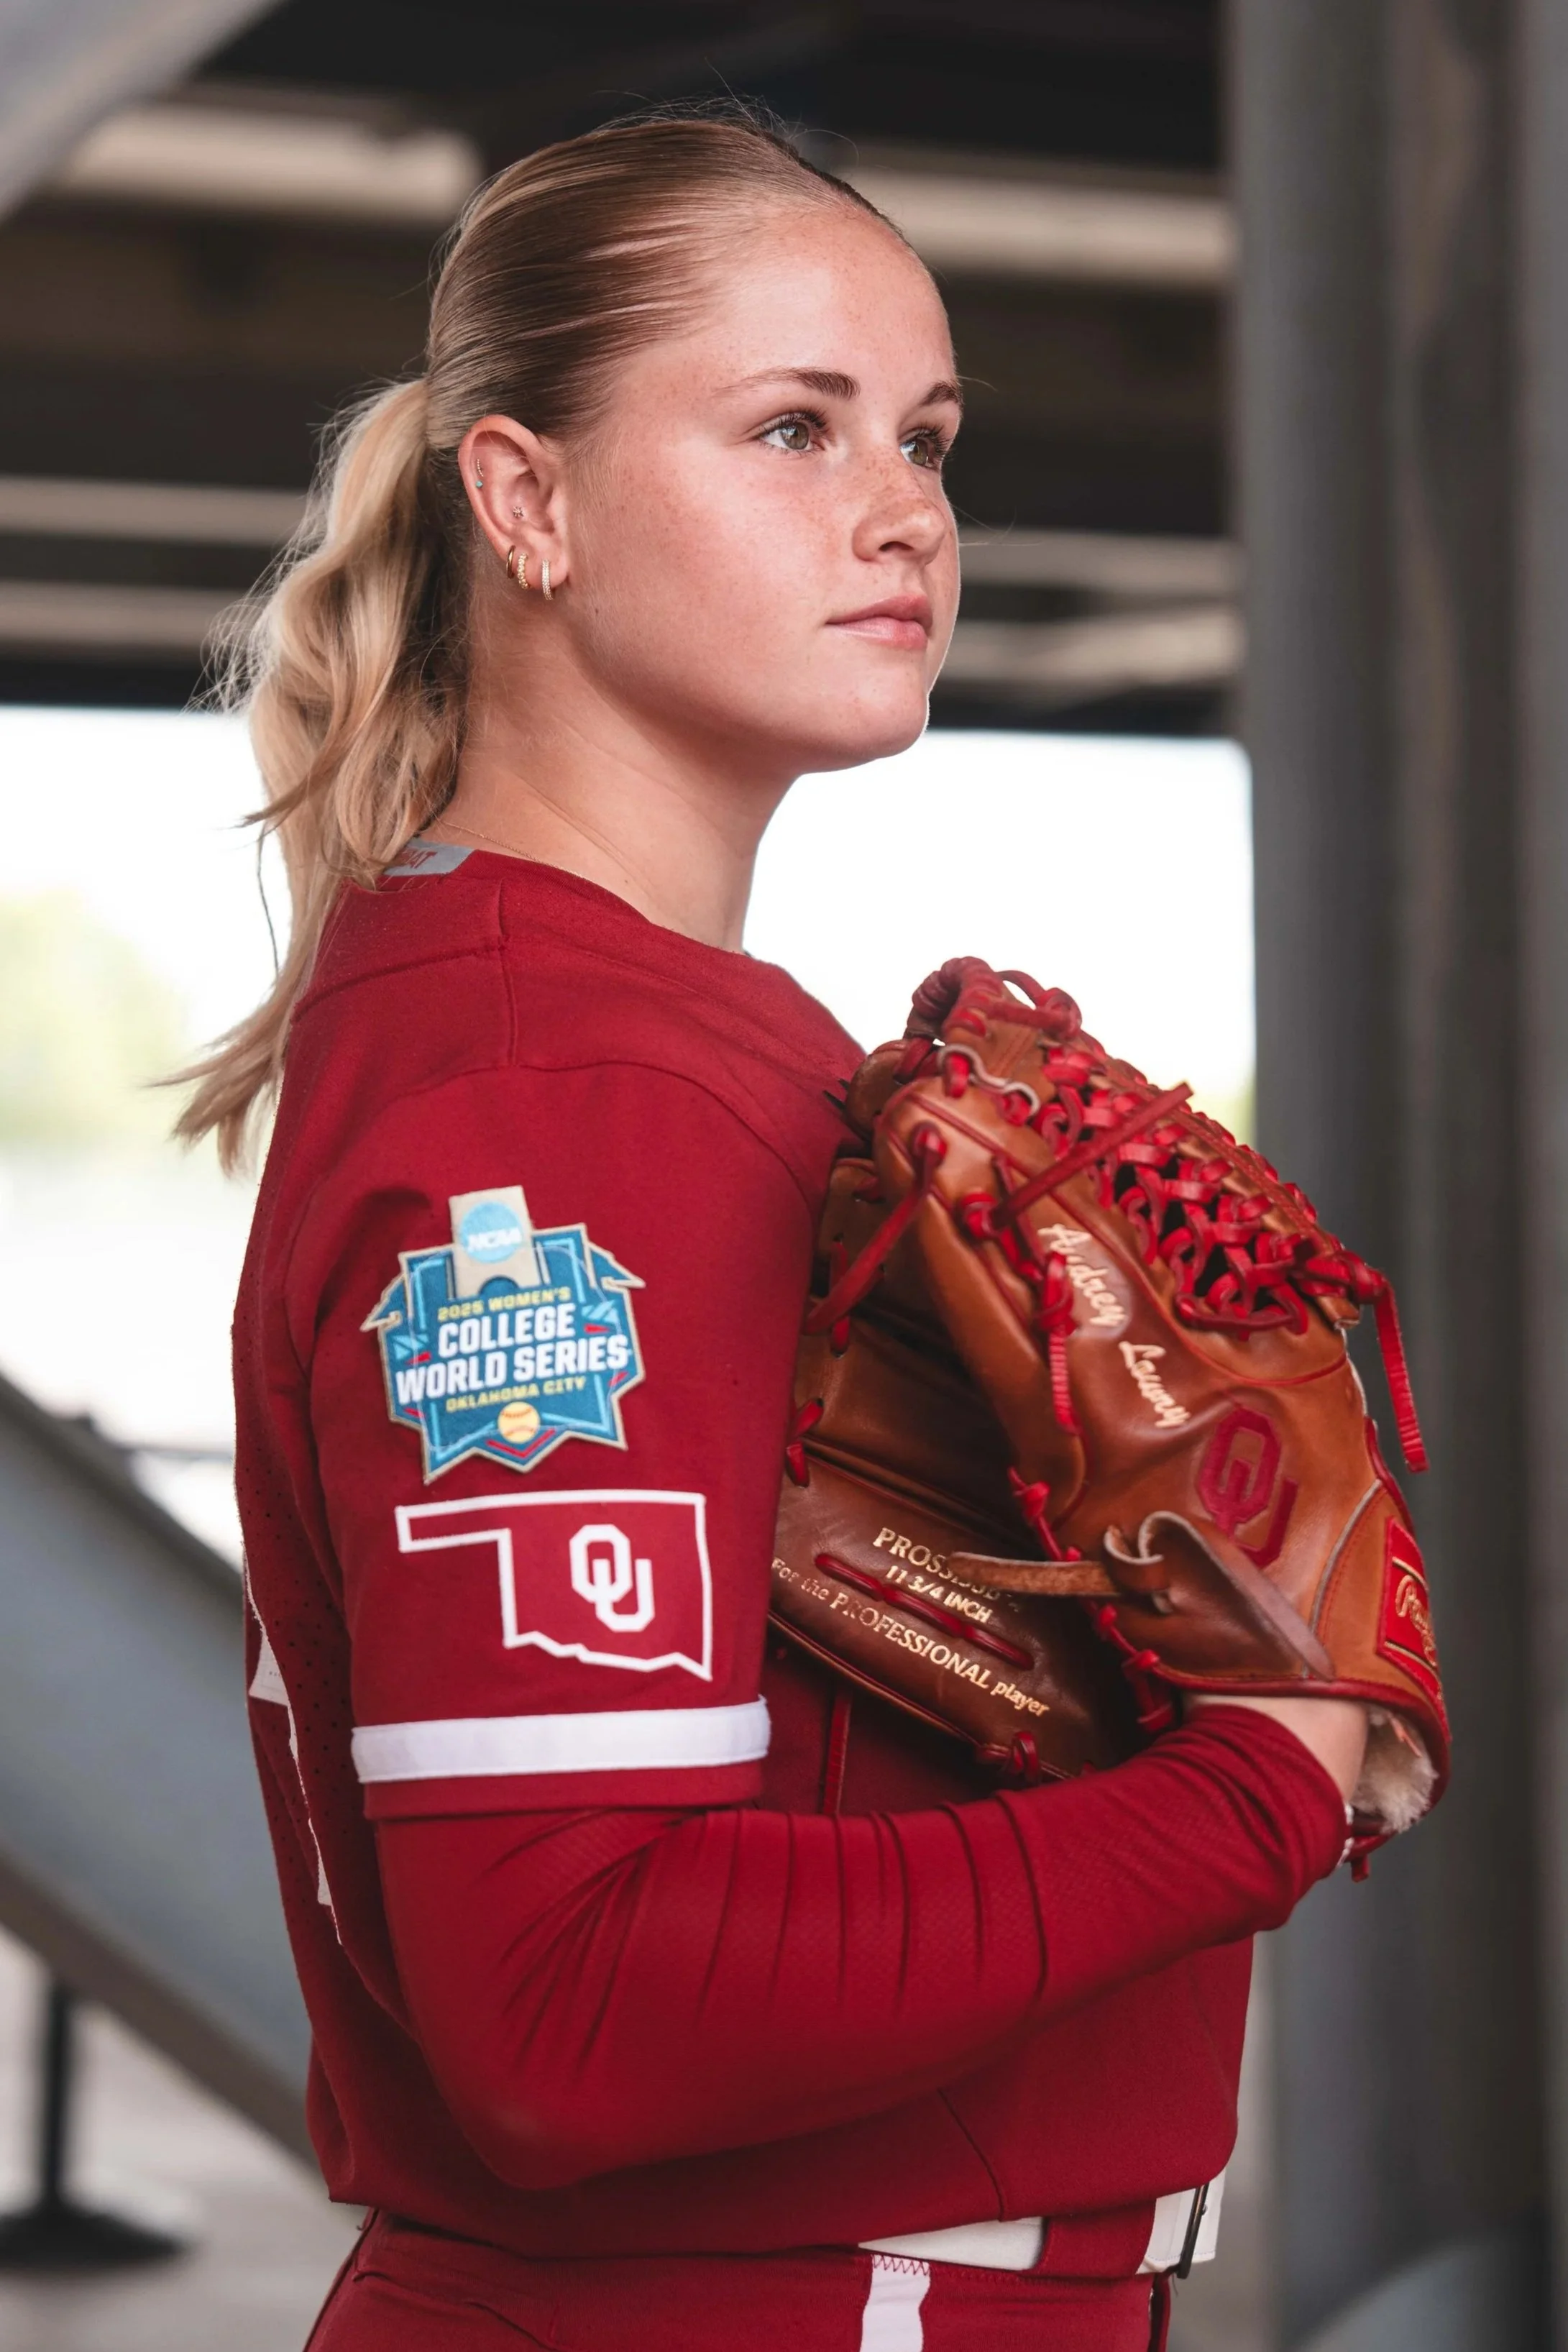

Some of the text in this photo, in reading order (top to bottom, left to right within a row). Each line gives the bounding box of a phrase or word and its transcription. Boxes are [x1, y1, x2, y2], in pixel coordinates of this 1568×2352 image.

[438, 1286, 571, 1322] 2025 WOMEN'S
[438, 1302, 576, 1358] COLLEGE
[395, 1334, 629, 1405] WORLD SERIES
[446, 1376, 587, 1413] OKLAHOMA CITY
[1119, 1341, 1191, 1427] Lowry
[569, 1524, 656, 1632] OU
[886, 1565, 993, 1624] 11 3/4 INCH
[771, 1557, 1050, 1717] For the PROFESSIONAL player
